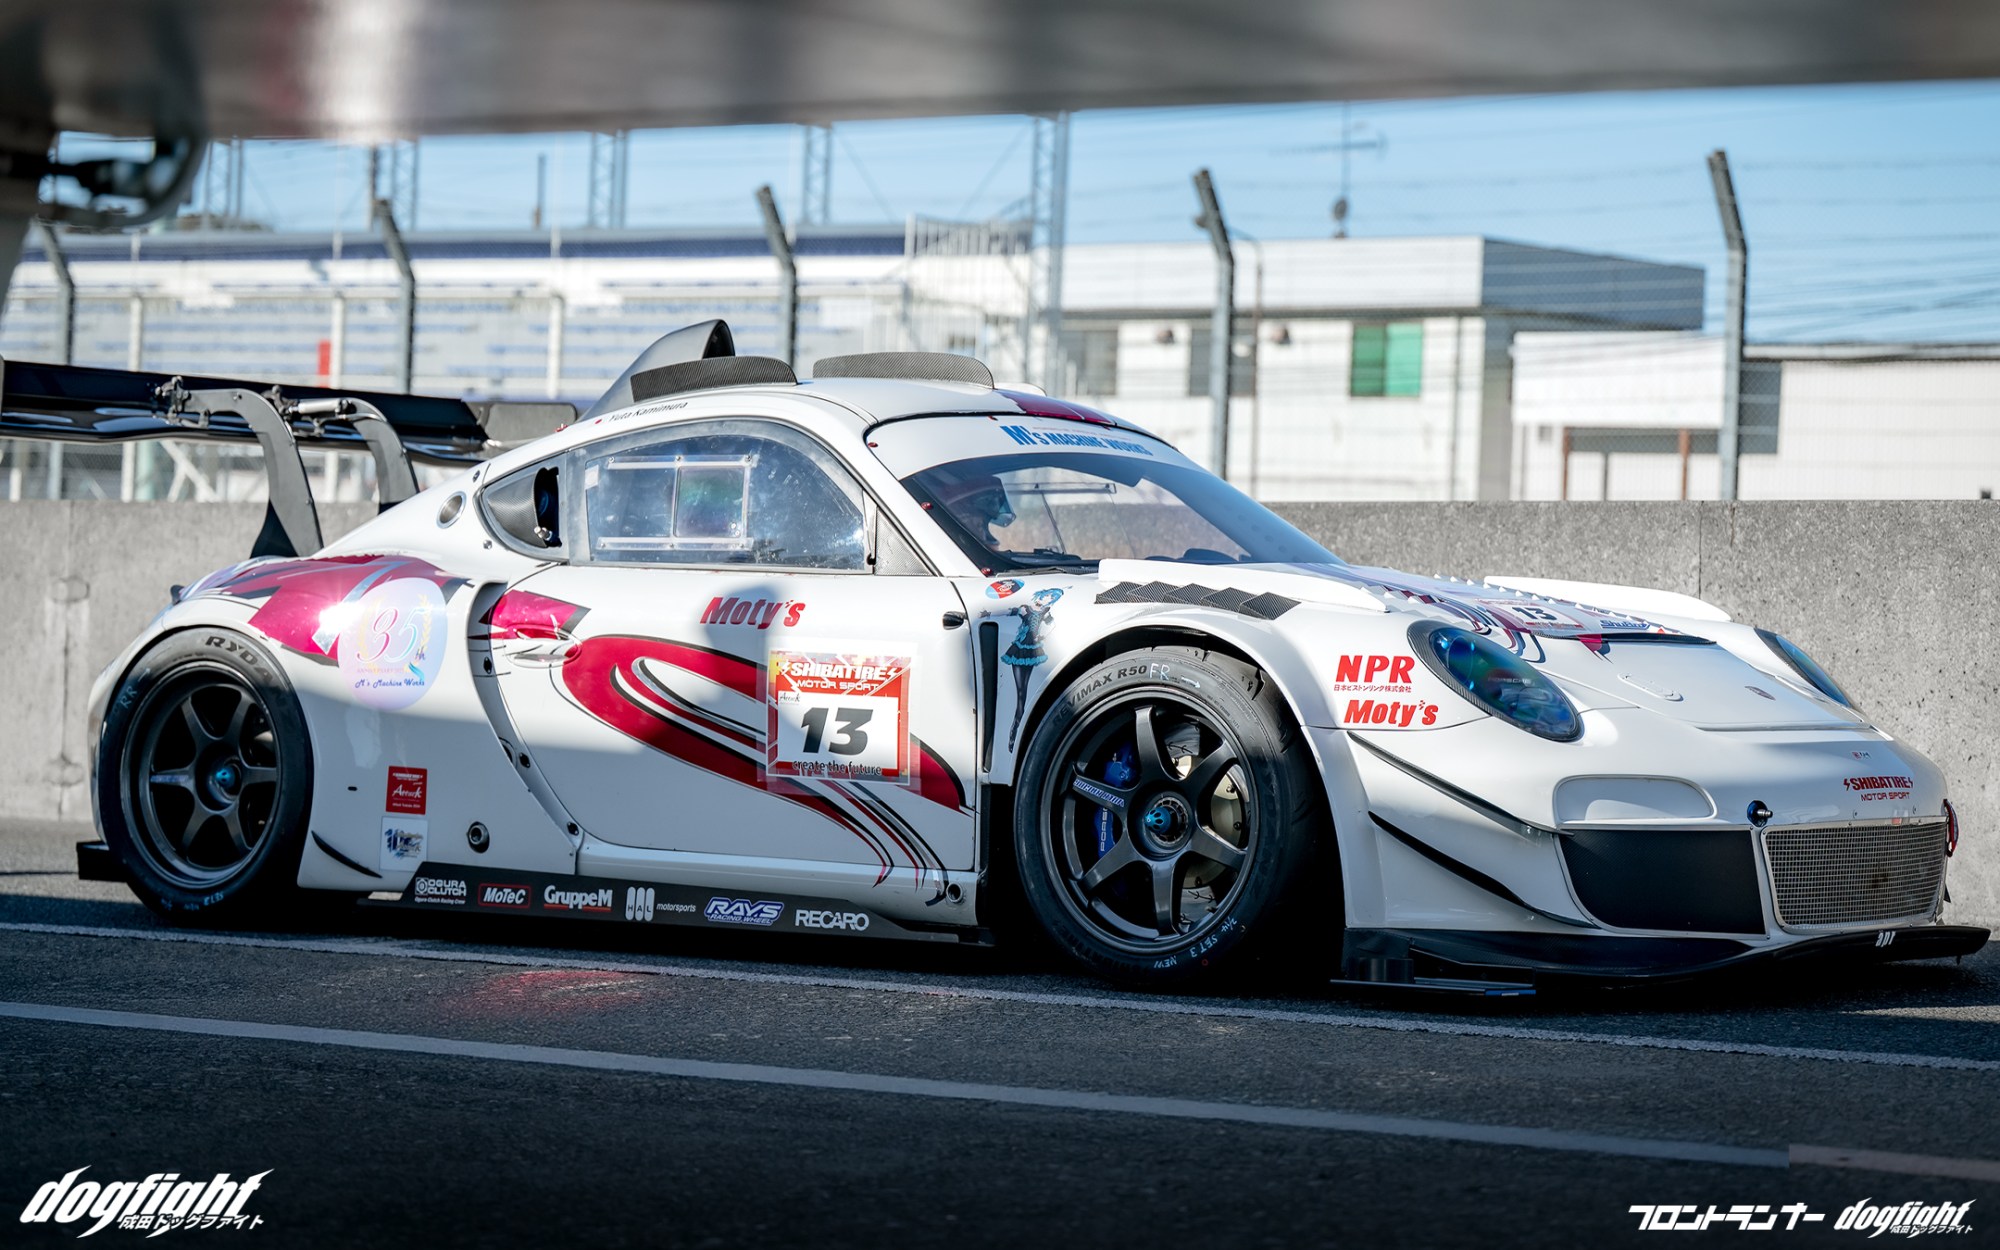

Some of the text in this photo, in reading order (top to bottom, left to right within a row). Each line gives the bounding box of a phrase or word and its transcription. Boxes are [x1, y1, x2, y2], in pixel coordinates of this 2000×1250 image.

[633, 402, 688, 417] Kamimura
[1044, 432, 1109, 449] MACHINE
[1102, 437, 1154, 456] WORKS
[700, 597, 806, 630] Moty's
[1511, 606, 1558, 621] 13
[790, 662, 888, 681] SHIBATIRE
[1149, 662, 1171, 681] FR
[1336, 655, 1415, 684] NPR
[372, 679, 402, 689] Machine
[403, 678, 425, 687] Works
[796, 680, 880, 692] MOTOR SPORT
[120, 685, 138, 710] RR
[1052, 664, 1148, 726] REVIMAX R50
[1343, 699, 1439, 728] Moty's
[801, 706, 874, 756] 13
[791, 760, 882, 776] create the future
[1849, 776, 1911, 791] SHIBATIRE
[1861, 791, 1910, 801] MOTOR SPORT
[427, 887, 467, 897] CLUTCH
[428, 879, 466, 889] OGURA
[483, 887, 526, 905] MoTeC
[544, 885, 613, 909] GruppeM
[656, 902, 697, 913] motorsports
[706, 900, 783, 918] RAYS
[710, 914, 773, 925] RACING WHEEL
[795, 909, 870, 931] RECARO
[1200, 936, 1219, 954] SET
